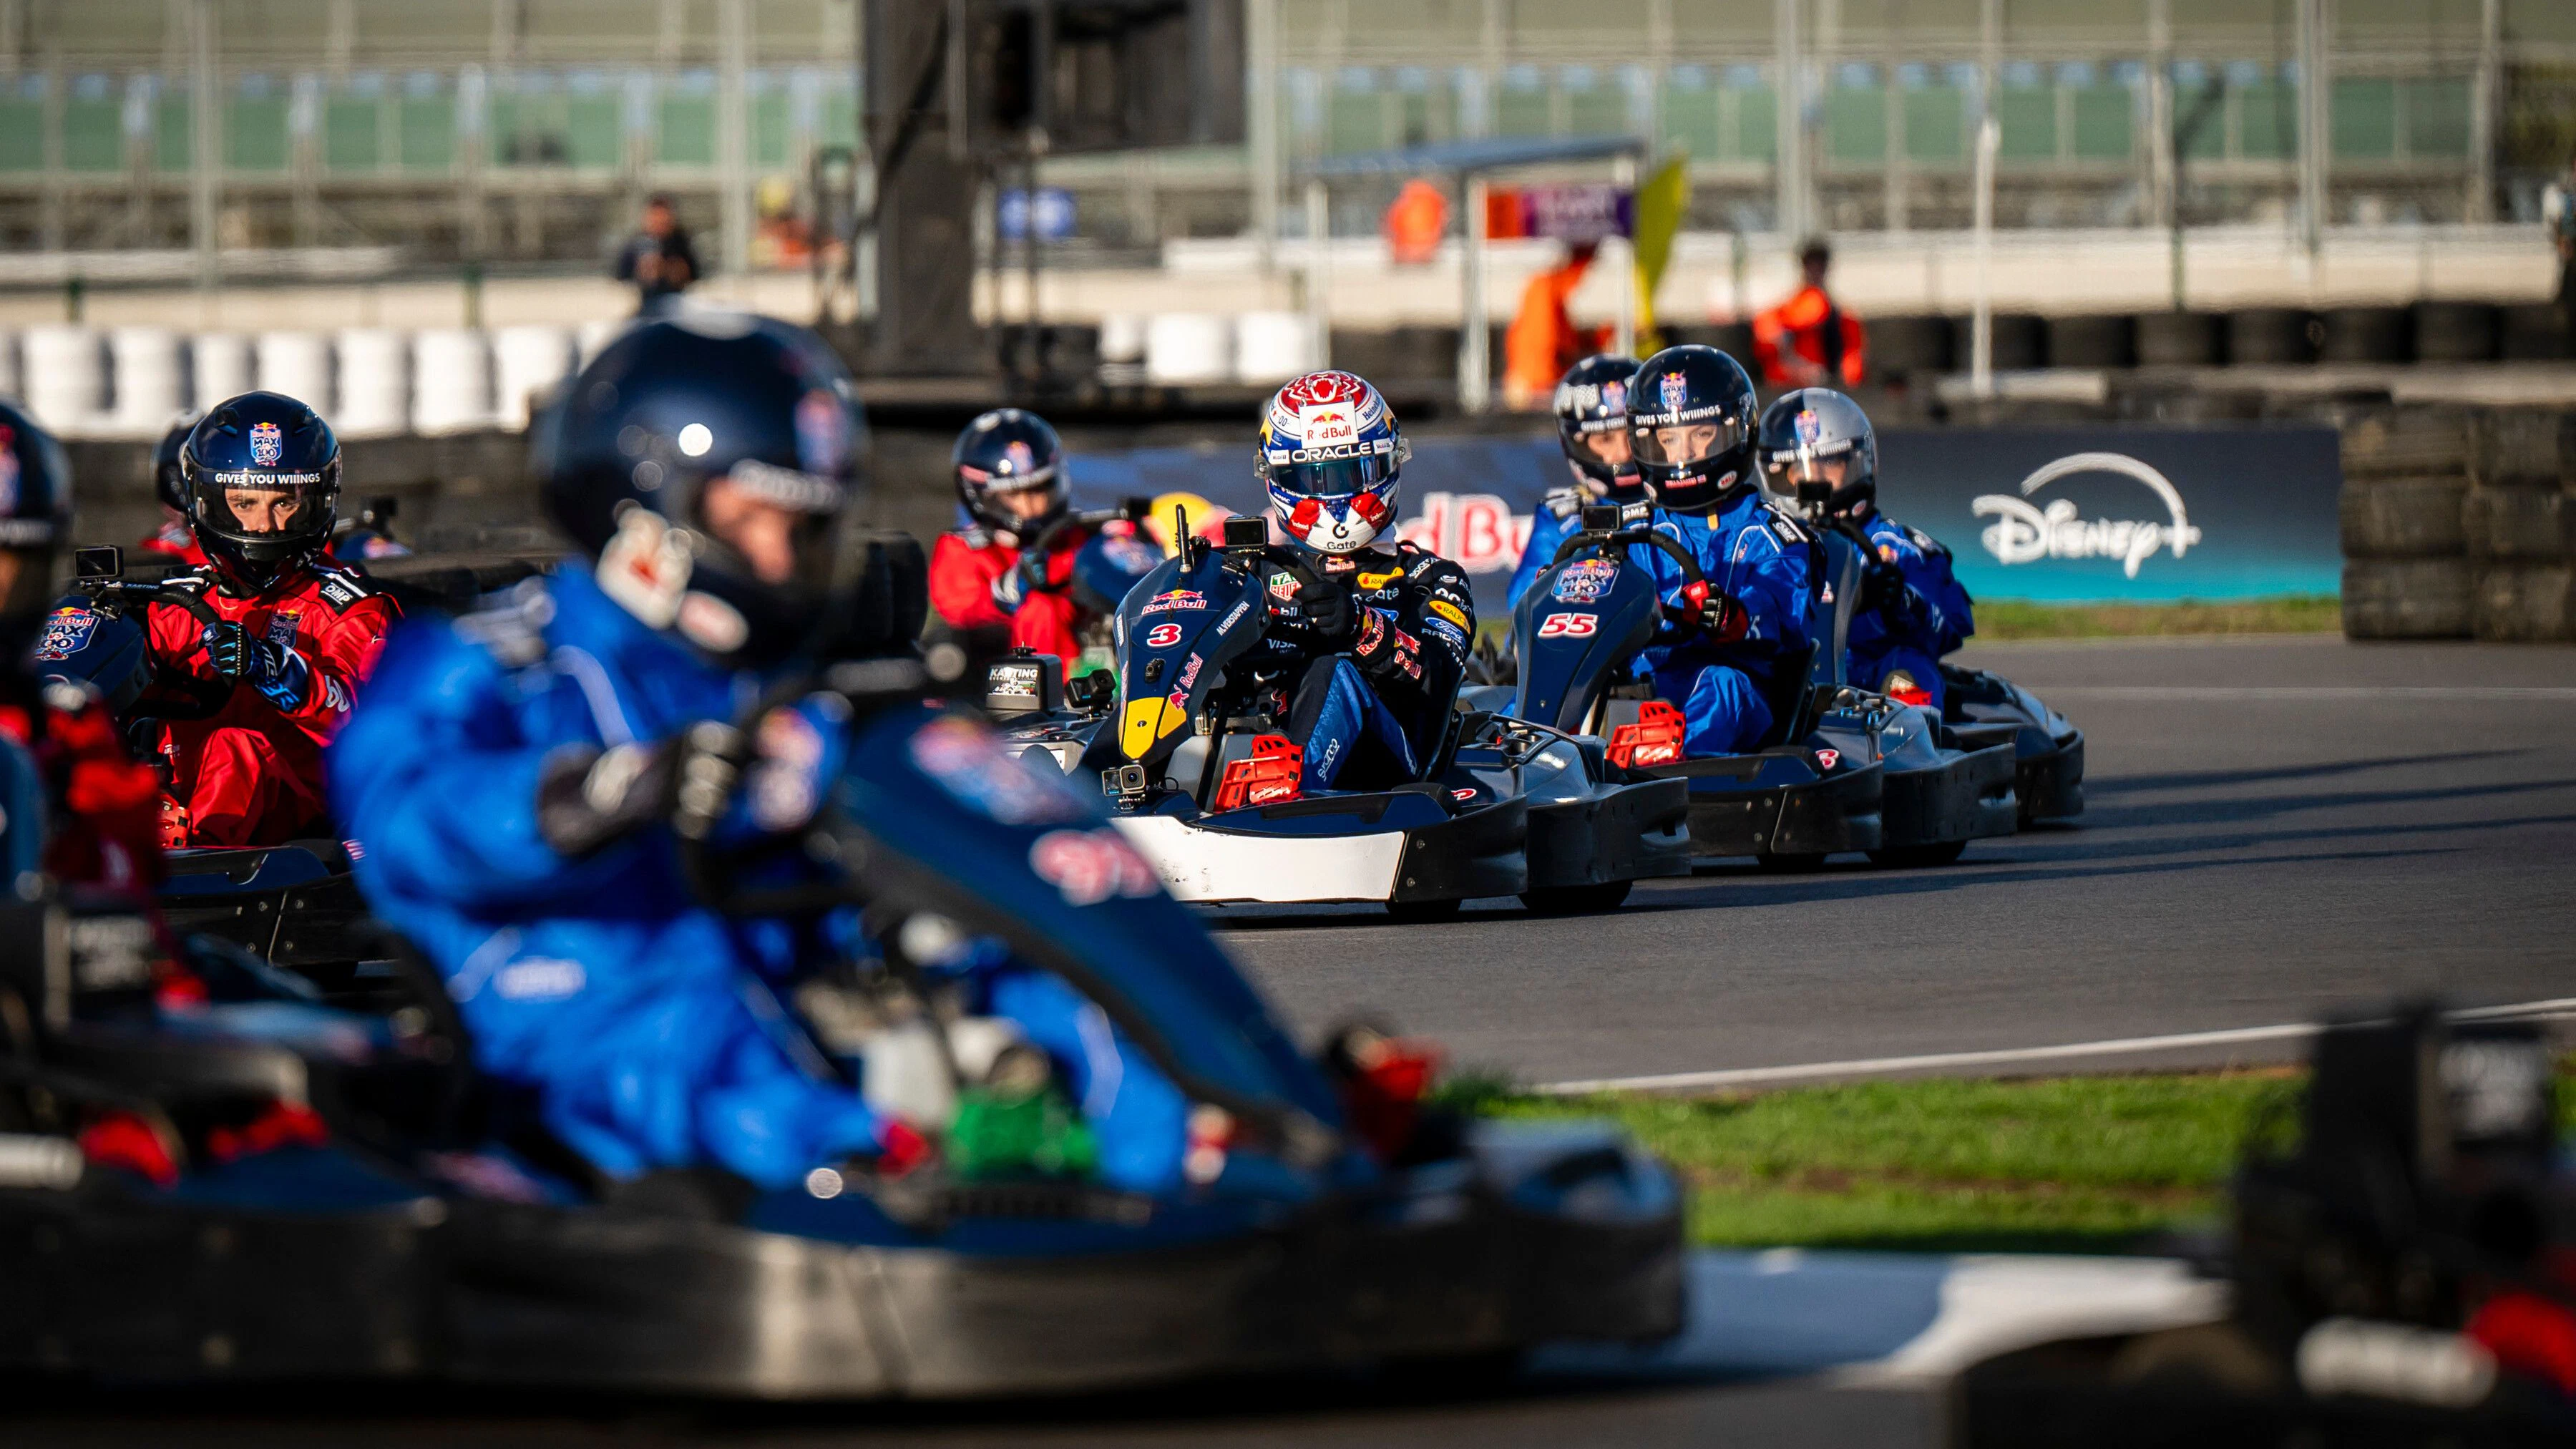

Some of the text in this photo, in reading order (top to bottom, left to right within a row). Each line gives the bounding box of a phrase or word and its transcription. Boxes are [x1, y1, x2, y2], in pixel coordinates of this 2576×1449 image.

[1635, 414, 1657, 426] GIVES
[1679, 404, 1722, 421] WIIINGS
[1307, 426, 1352, 440] Rd Bull
[253, 437, 280, 447] MAX
[1292, 441, 1372, 462] ORACLE
[215, 473, 321, 484] GIVES YOU WIIINGS
[1327, 540, 1357, 550] Gate
[1342, 561, 1355, 570] Bull
[325, 583, 351, 602] OMP
[1141, 600, 1208, 615] Red Bull
[1268, 605, 1298, 616] obil
[64, 616, 94, 625] Bull
[1537, 613, 1599, 639] 55
[50, 625, 87, 638] AX
[1146, 623, 1182, 647] 3
[1435, 620, 1464, 641] Ford
[990, 667, 1038, 678] KARTING
[1318, 738, 1340, 781] sparco
